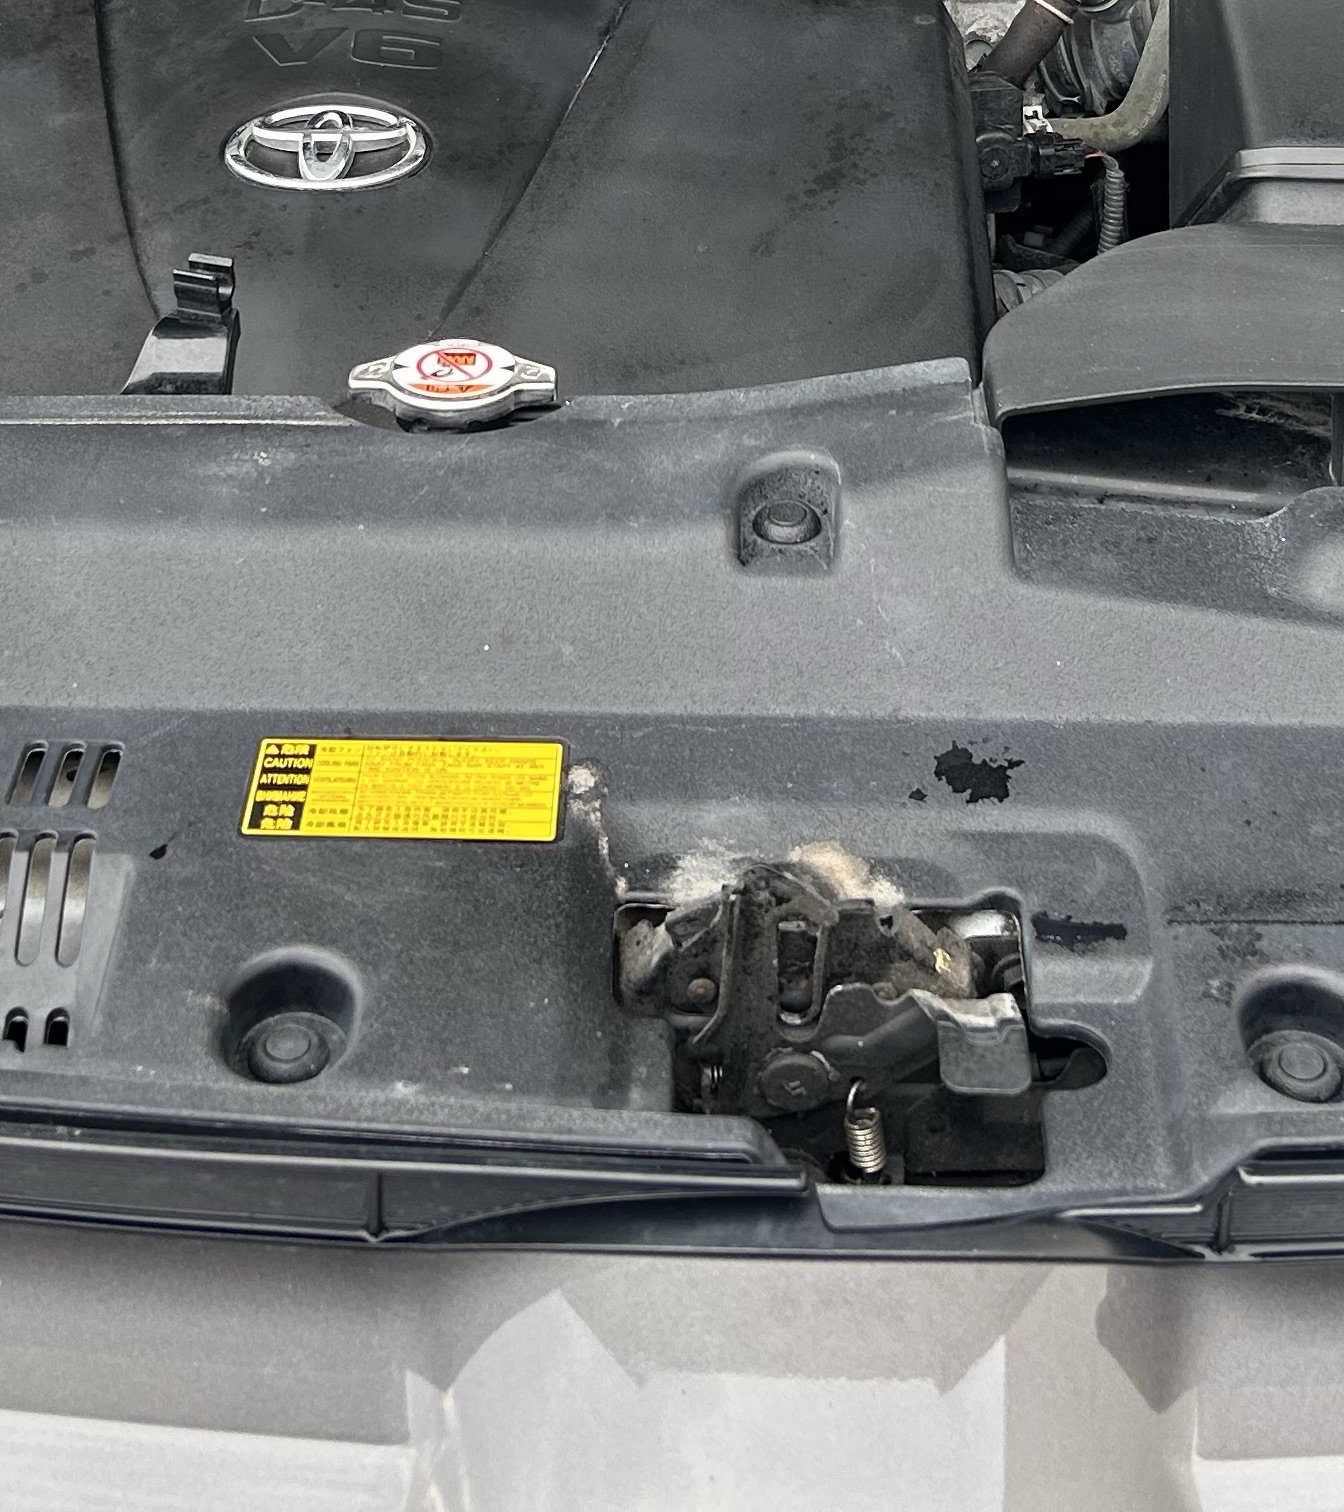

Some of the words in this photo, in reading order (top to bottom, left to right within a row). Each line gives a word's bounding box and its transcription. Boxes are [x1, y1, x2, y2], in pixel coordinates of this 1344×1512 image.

[251, 28, 444, 70] V6
[263, 757, 314, 769] CAUTION
[259, 773, 310, 785] ATTENTION
